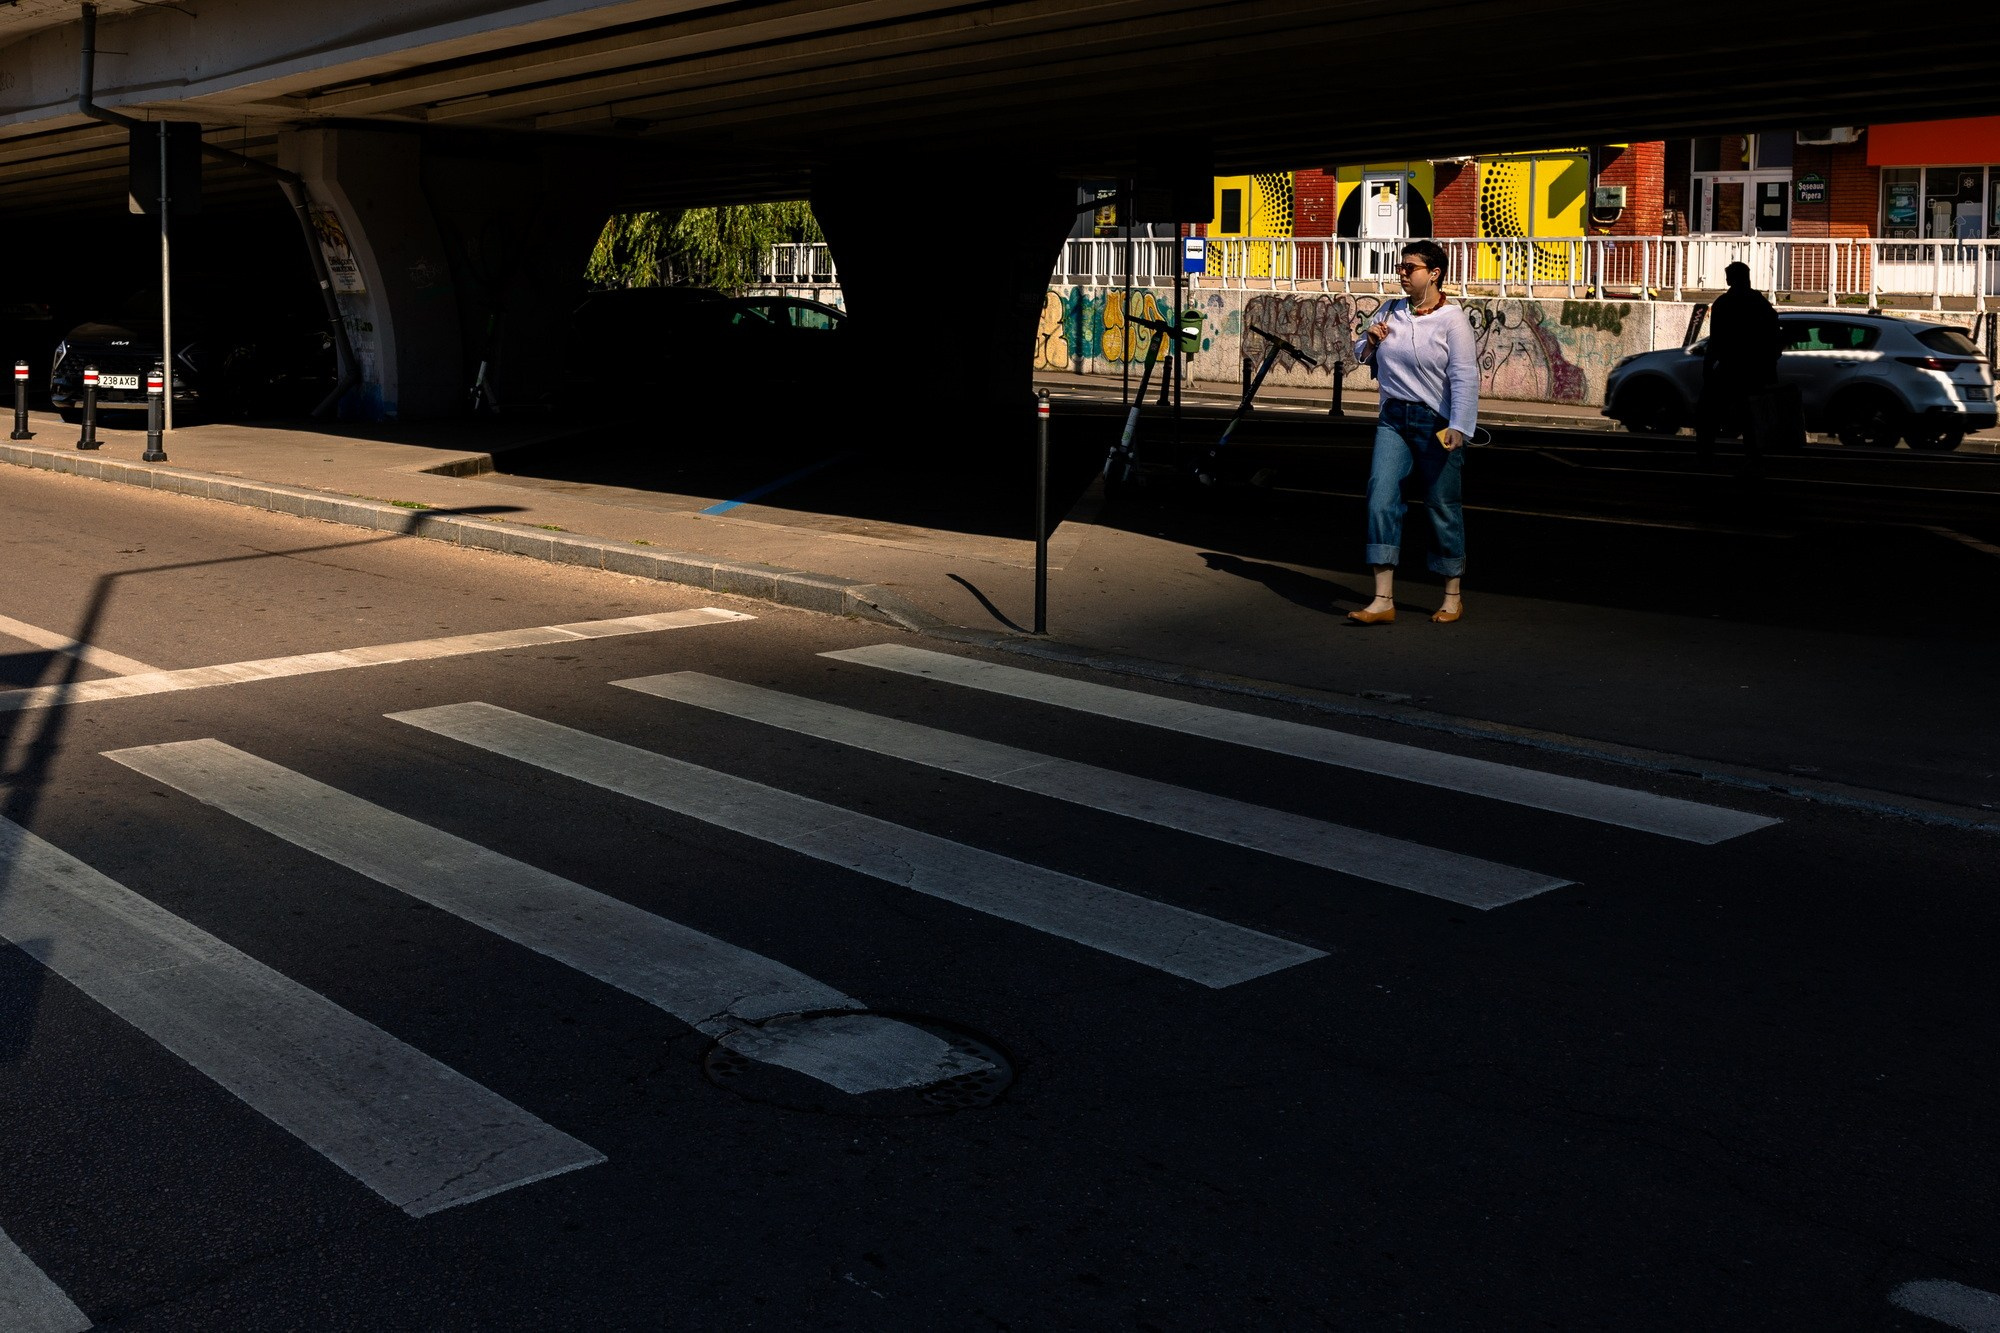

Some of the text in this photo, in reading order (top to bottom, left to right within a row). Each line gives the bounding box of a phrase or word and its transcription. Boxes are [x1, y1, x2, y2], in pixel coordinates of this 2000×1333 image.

[1801, 192, 1822, 201] Pipera
[103, 377, 118, 385] 238
[119, 377, 137, 385] AXB
